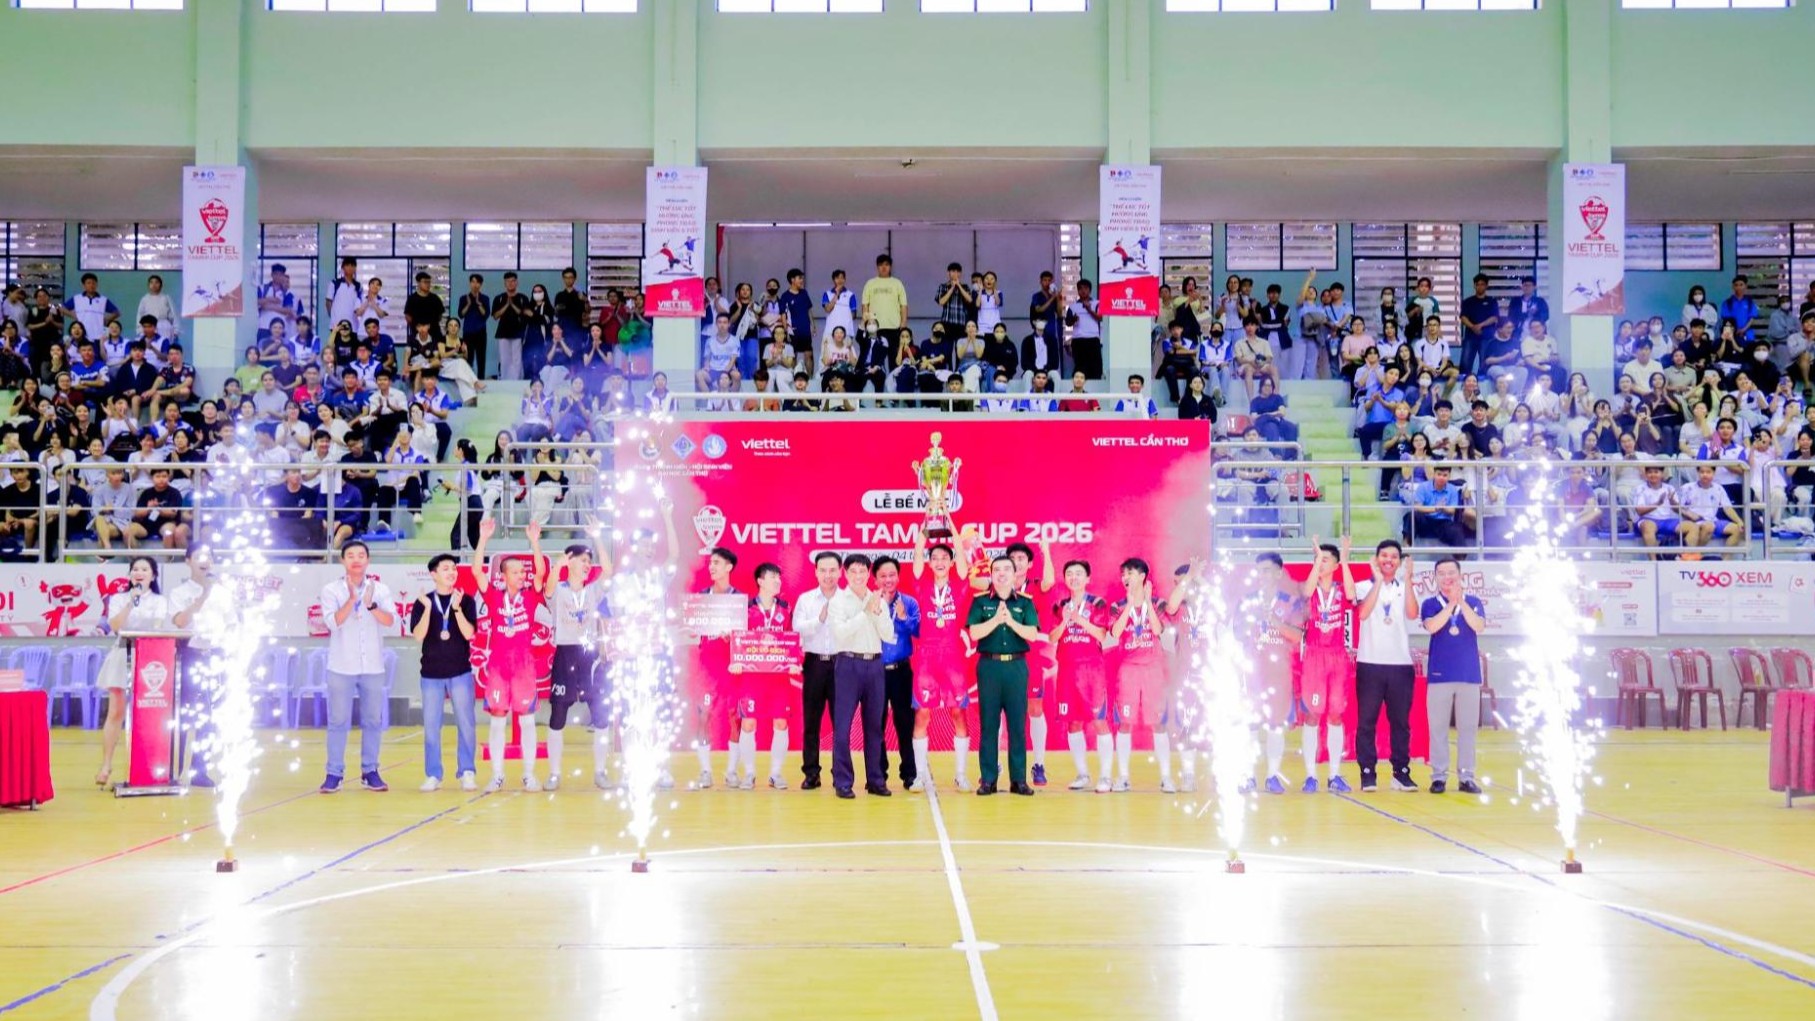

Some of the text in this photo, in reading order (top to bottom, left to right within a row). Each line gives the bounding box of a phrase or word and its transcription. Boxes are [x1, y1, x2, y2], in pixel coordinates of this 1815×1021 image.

[188, 245, 239, 254] VIETTEL
[1568, 242, 1619, 252] VIETTEL
[741, 438, 790, 449] viettel
[1092, 432, 1189, 446] VIETTEL CẦN THƠ
[875, 493, 892, 508] LỄ
[895, 493, 914, 508] BẾ
[731, 522, 851, 544] VIETTEL
[1024, 522, 1093, 544] 2026
[1736, 572, 1772, 583] XEM
[734, 654, 784, 662] 10.000.000
[748, 699, 755, 712] 3
[1059, 703, 1069, 715] 10
[1123, 705, 1131, 717] 6
